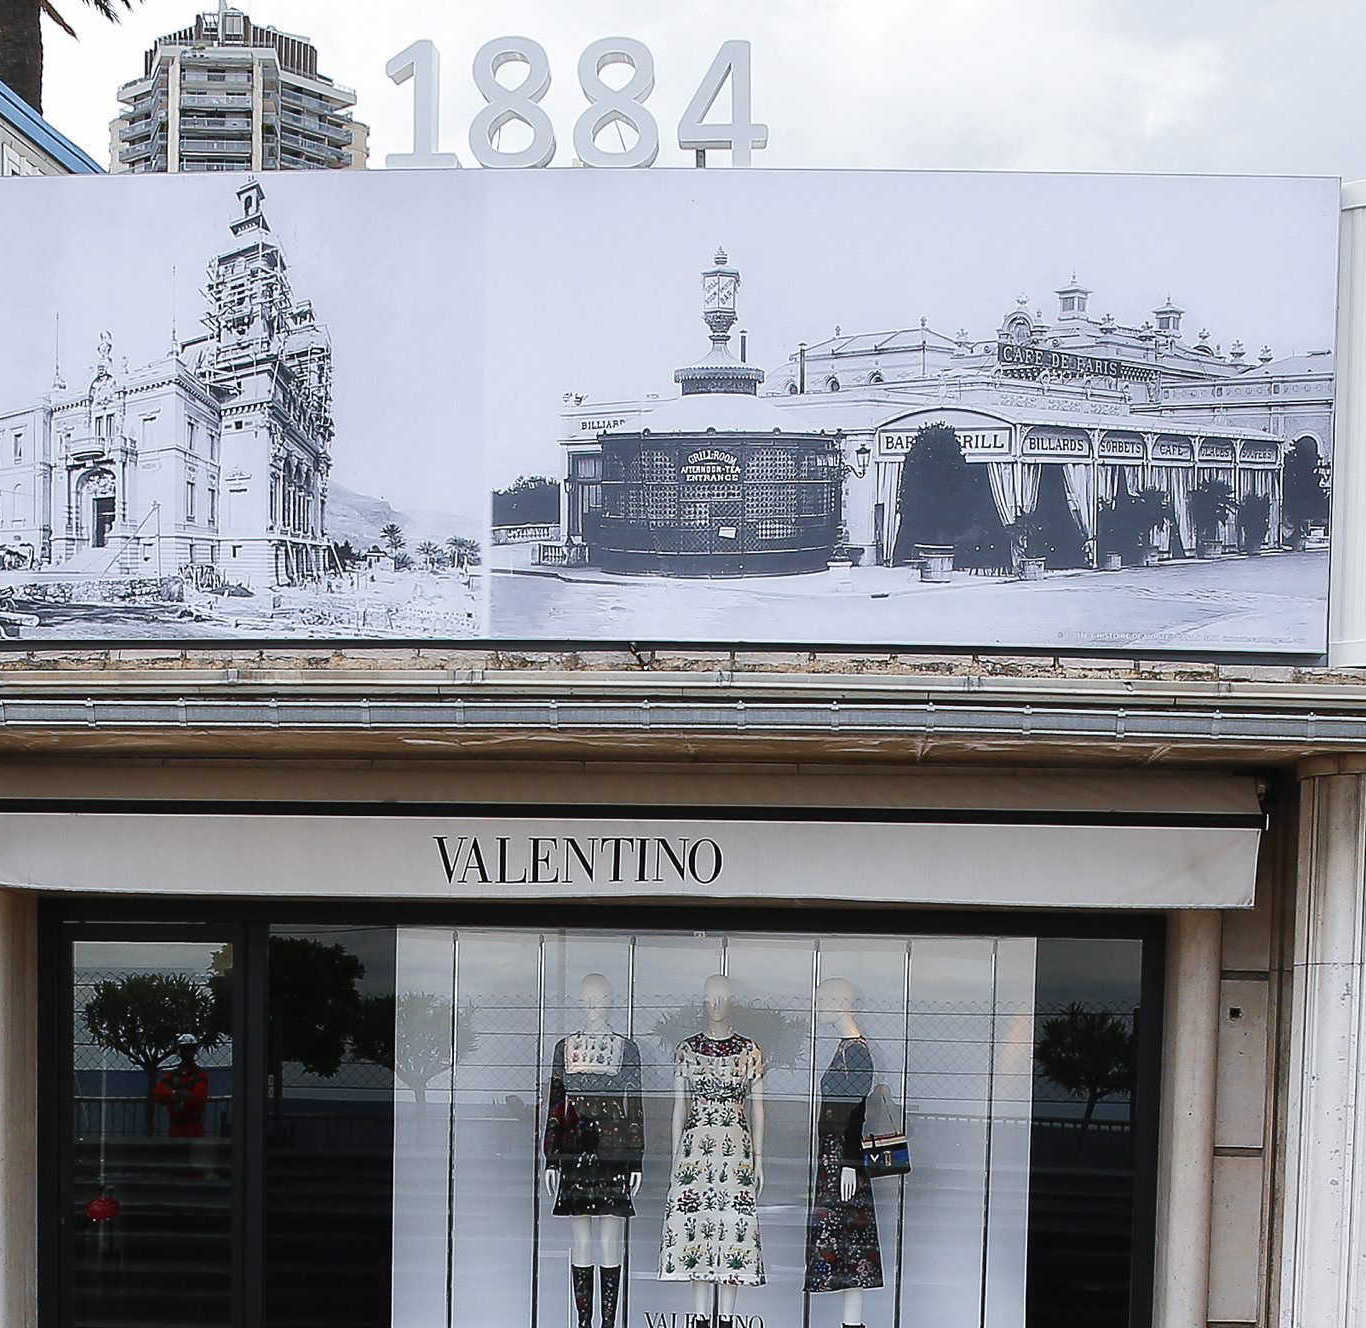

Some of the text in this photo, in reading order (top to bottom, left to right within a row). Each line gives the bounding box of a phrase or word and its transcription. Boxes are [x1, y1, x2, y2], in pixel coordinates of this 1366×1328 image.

[385, 36, 768, 168] 1884
[1051, 353, 1069, 369] DE
[1077, 356, 1118, 376] PARIS
[885, 435, 915, 449] BAR
[1029, 437, 1085, 451] BILLARDS
[1100, 441, 1142, 454] SORBETS
[686, 474, 739, 482] ENTRANCE
[432, 835, 724, 885] VALENTINO
